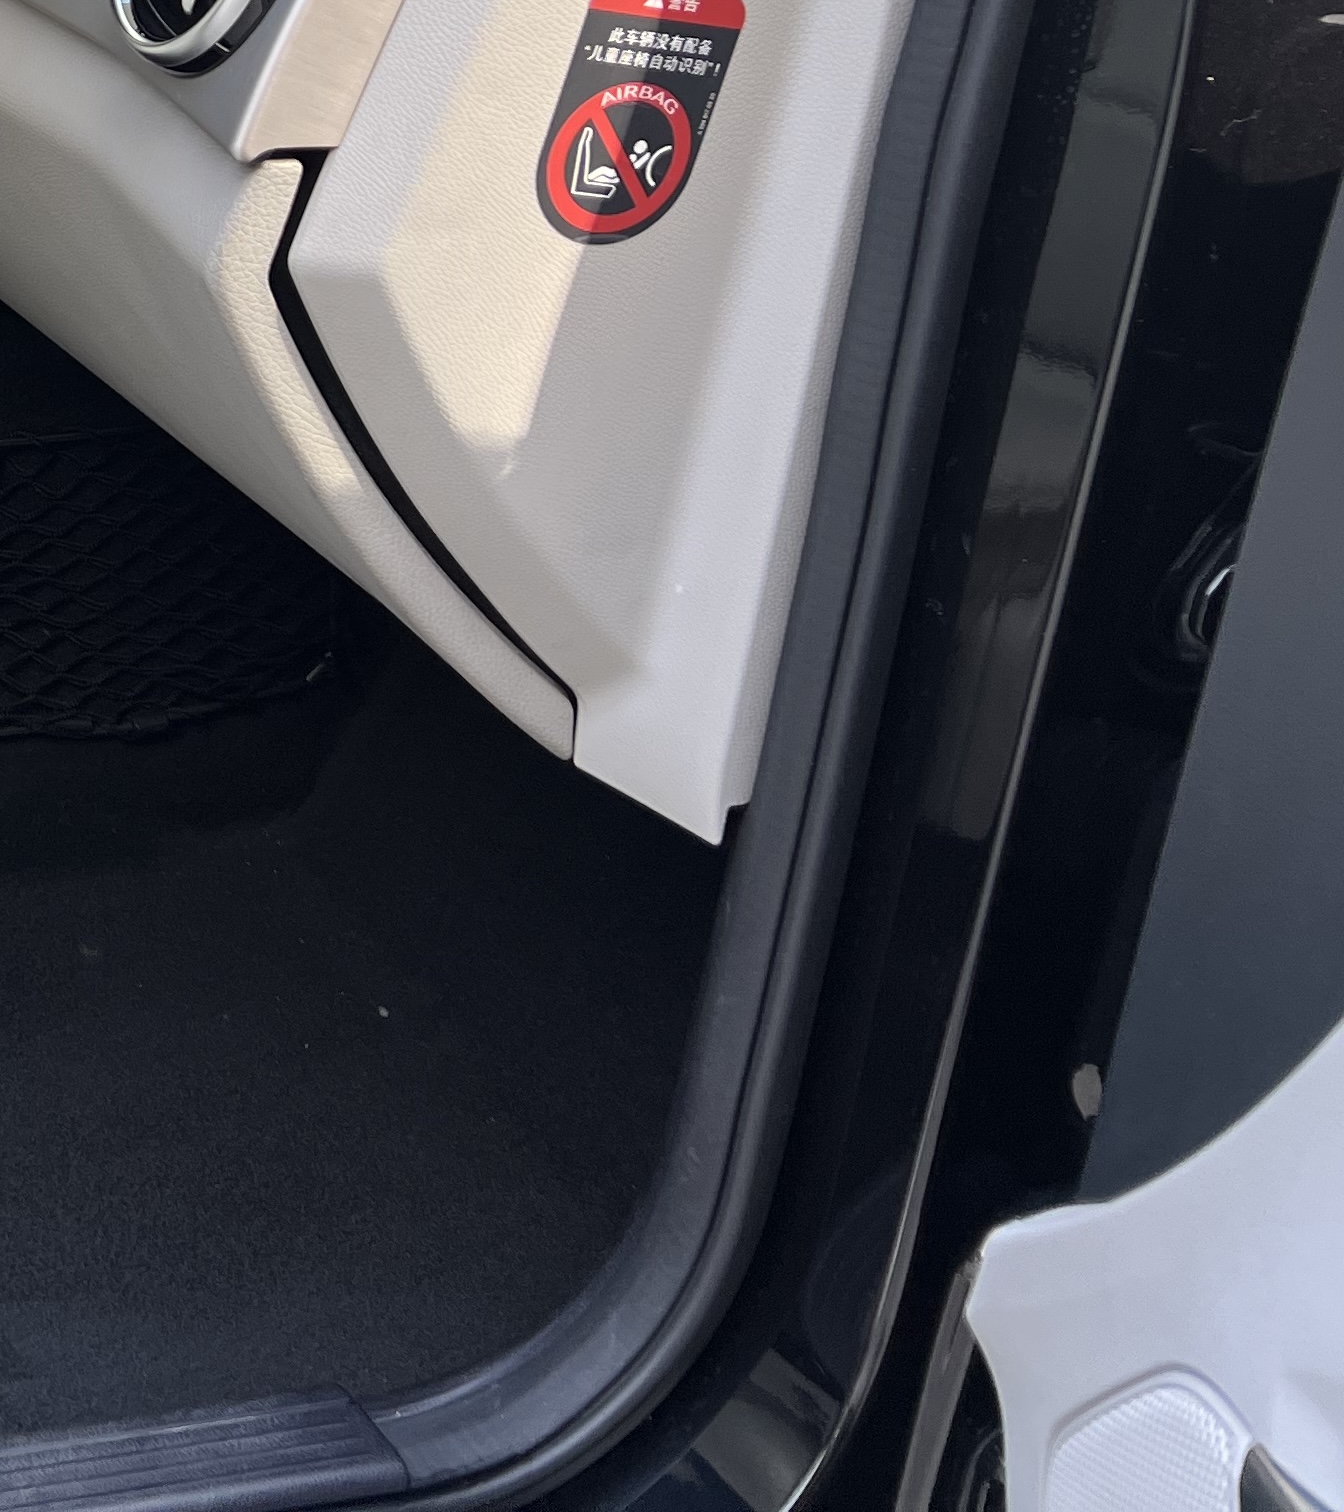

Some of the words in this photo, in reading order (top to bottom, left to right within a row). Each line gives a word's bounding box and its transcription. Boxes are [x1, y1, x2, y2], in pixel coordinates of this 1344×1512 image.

[608, 27, 713, 56] 此车辆没有配备
[601, 85, 679, 115] AIRBAG
